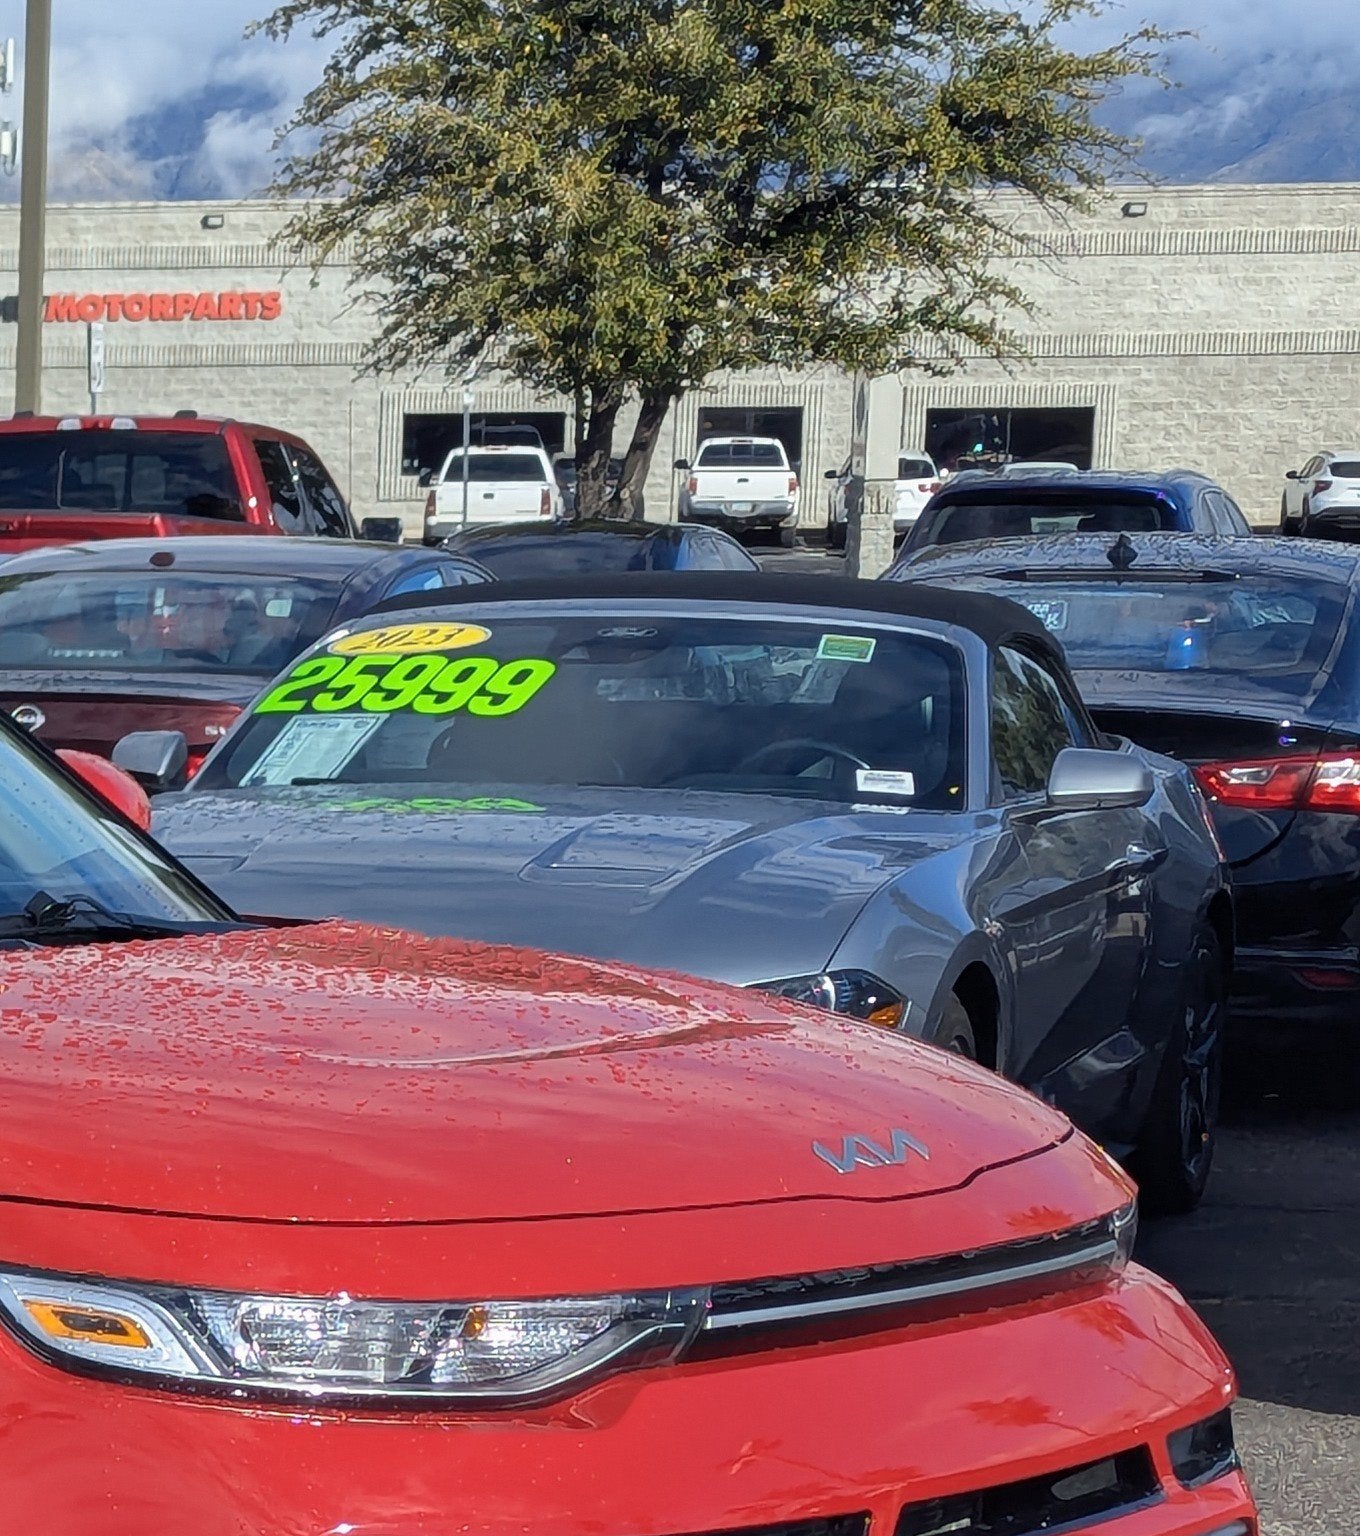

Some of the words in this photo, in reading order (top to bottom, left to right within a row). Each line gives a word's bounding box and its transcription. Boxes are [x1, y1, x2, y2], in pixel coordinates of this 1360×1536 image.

[44, 292, 281, 323] MOTORPARTS
[346, 627, 466, 650] 2023
[254, 654, 557, 717] 25999
